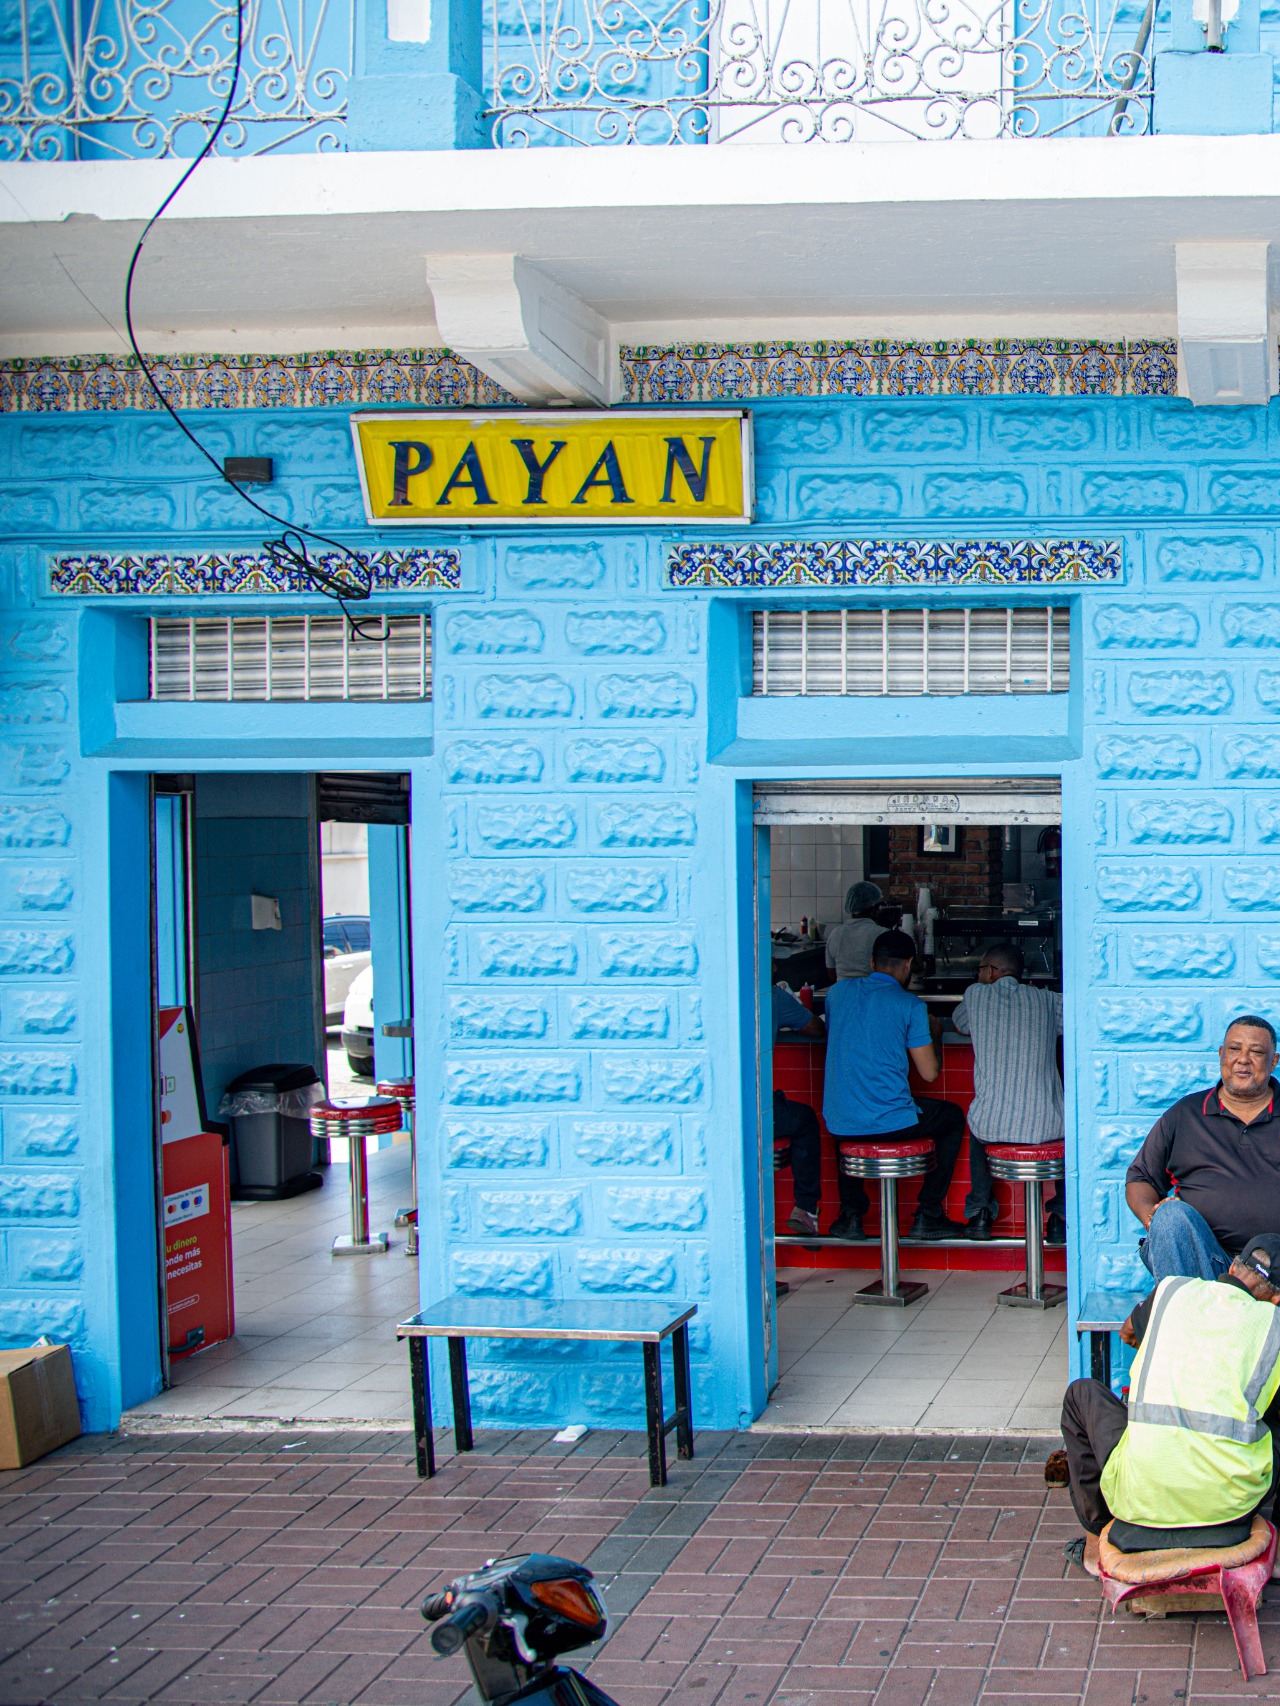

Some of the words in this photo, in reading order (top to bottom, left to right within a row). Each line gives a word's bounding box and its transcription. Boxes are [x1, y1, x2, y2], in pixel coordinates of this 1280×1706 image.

[387, 436, 717, 507] PAYAN
[173, 1236, 198, 1251] dinero
[165, 1253, 184, 1267] onde
[184, 1247, 201, 1260] más
[167, 1260, 203, 1280] necesitas
